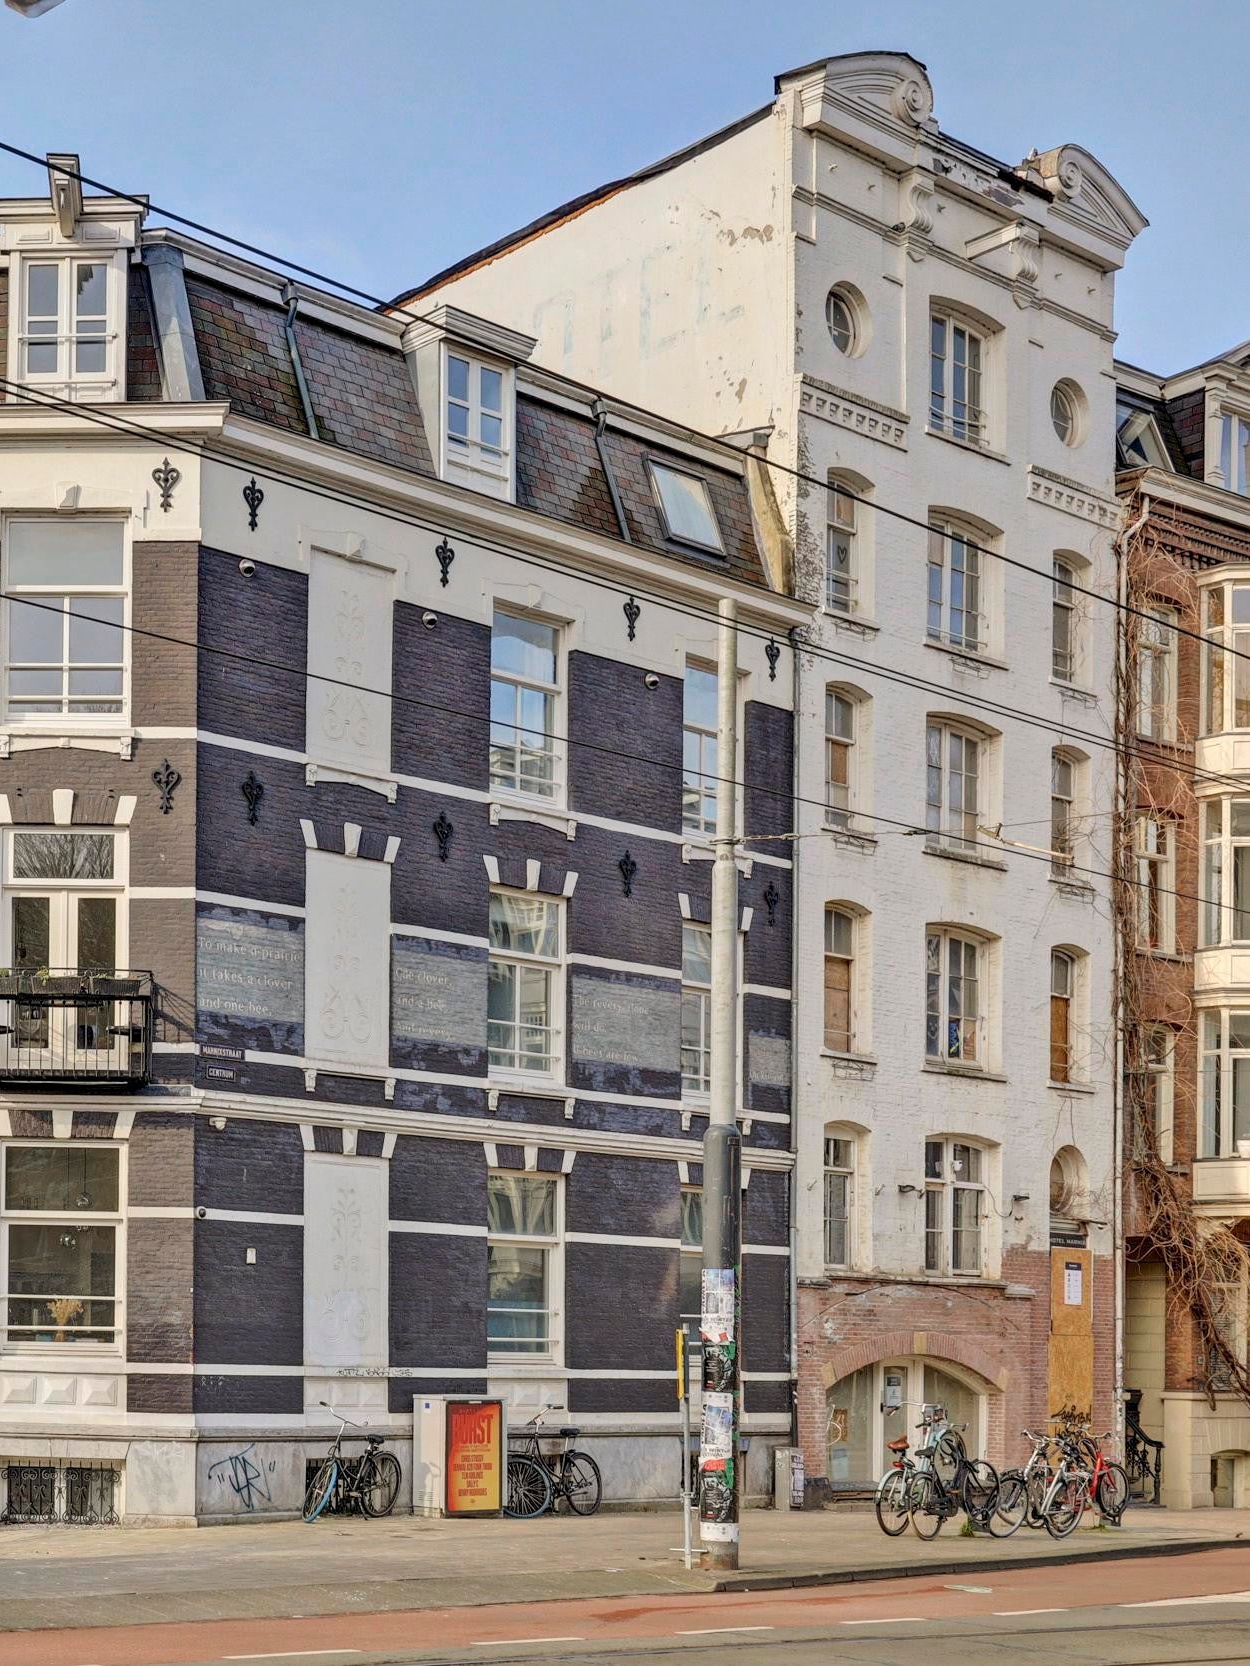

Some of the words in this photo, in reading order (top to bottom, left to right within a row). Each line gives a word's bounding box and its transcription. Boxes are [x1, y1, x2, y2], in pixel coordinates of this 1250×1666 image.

[198, 936, 212, 951] To
[216, 942, 247, 955] make
[261, 949, 302, 961] prairie
[212, 968, 243, 984] takes
[257, 975, 294, 990] clover
[199, 996, 220, 1010] and
[224, 1000, 245, 1012] one
